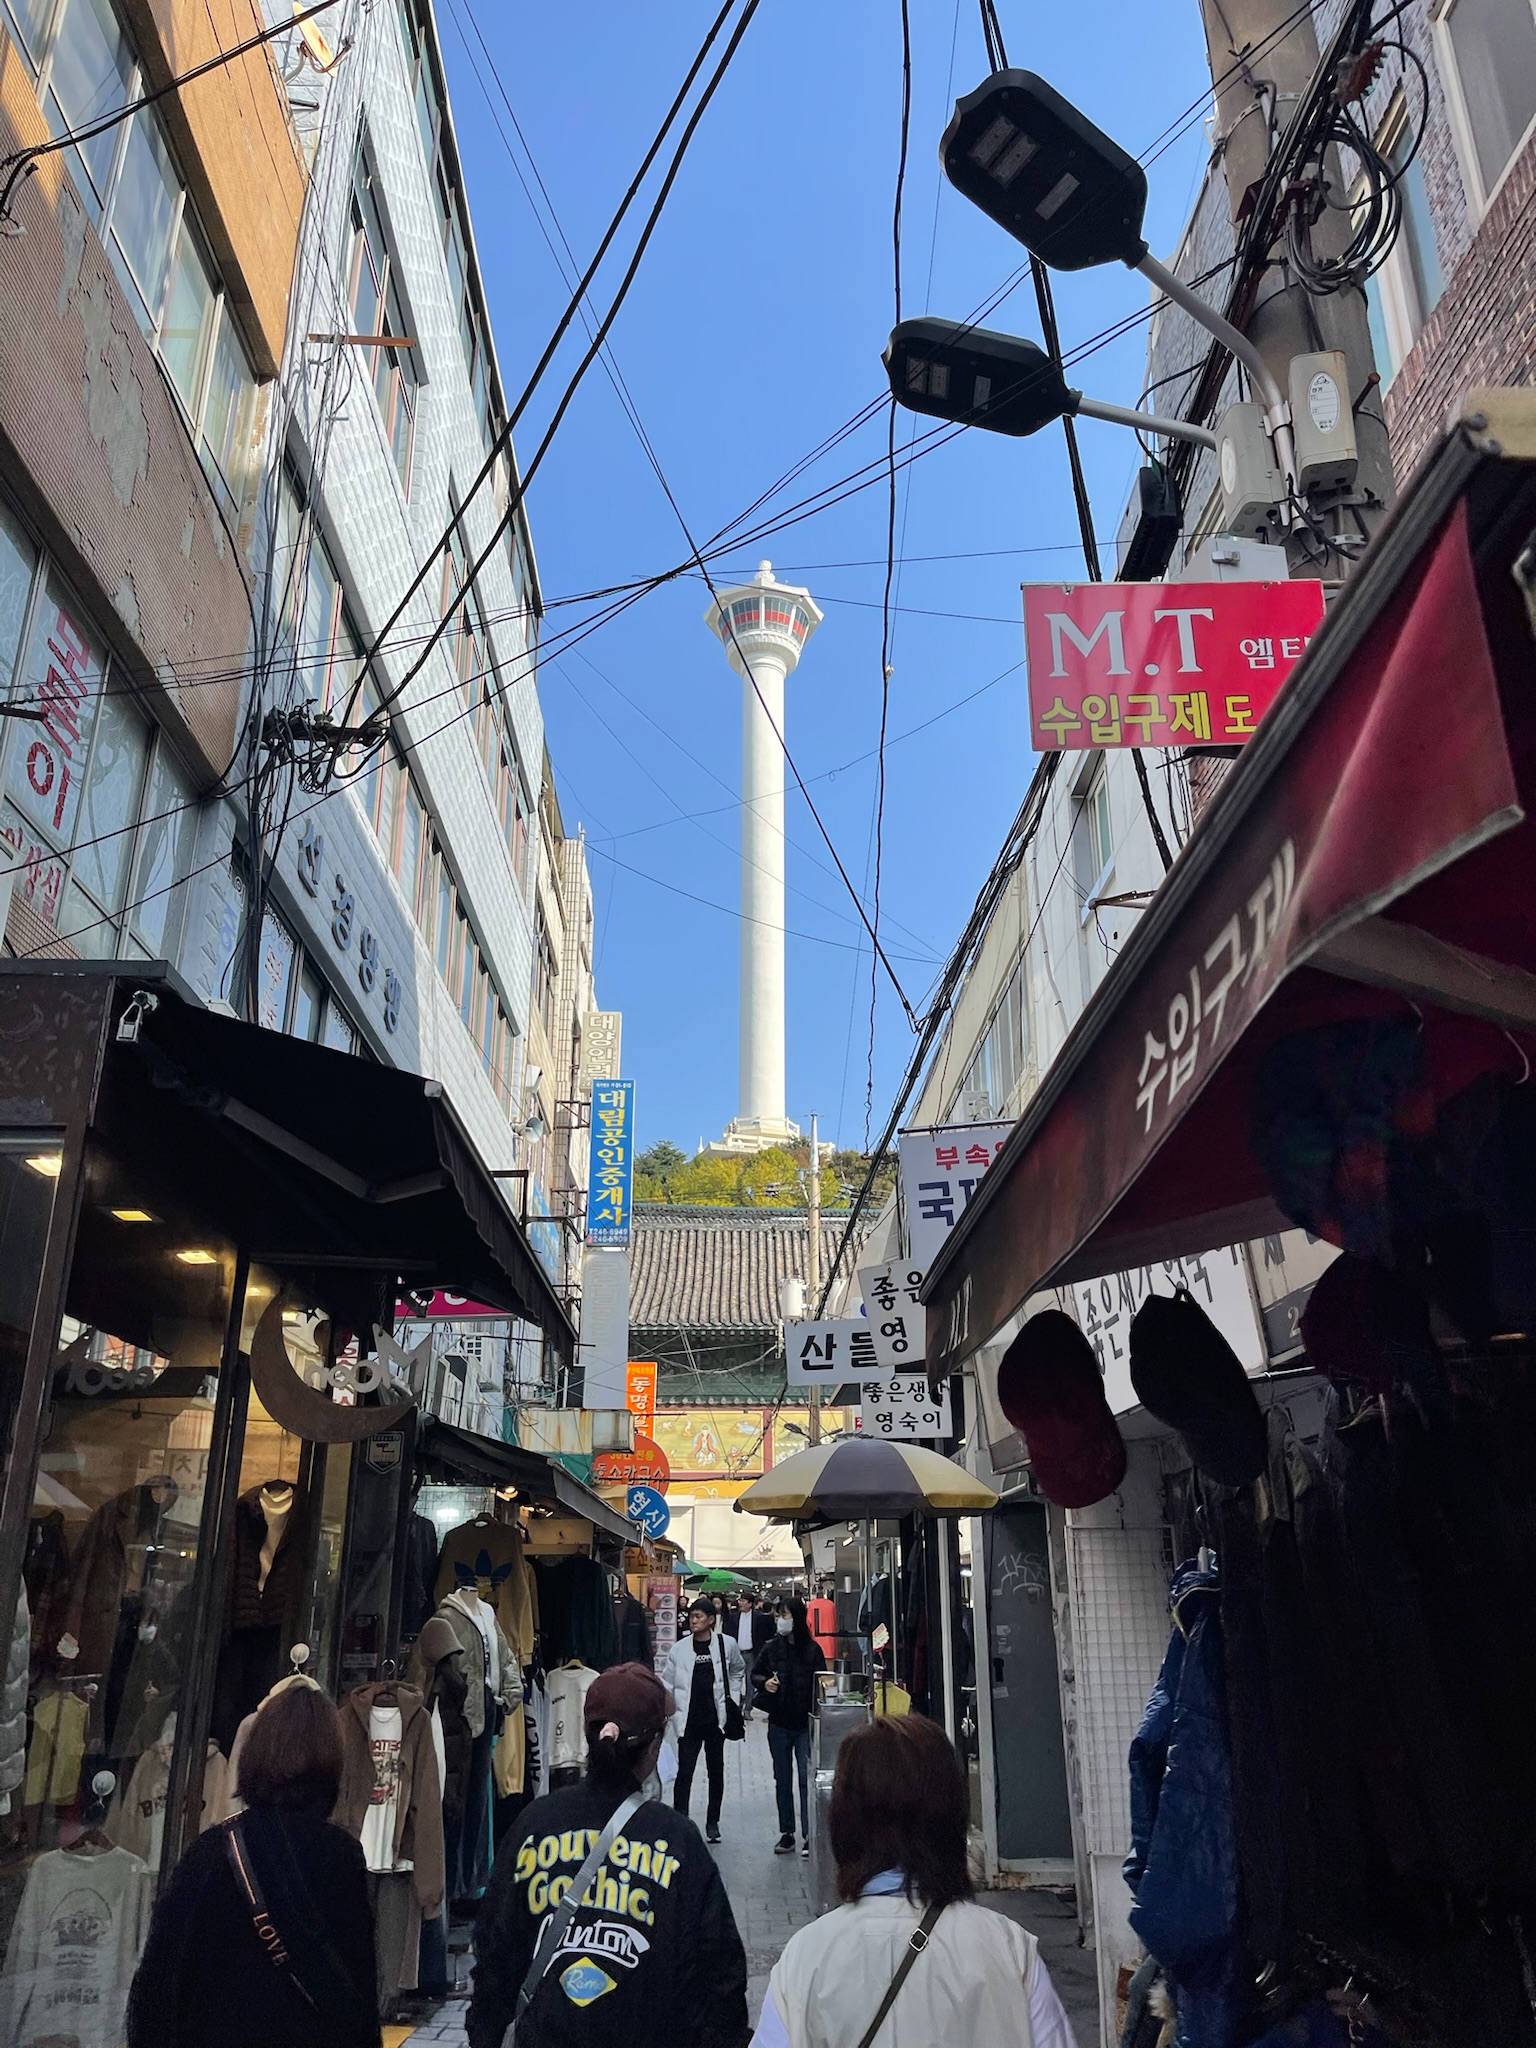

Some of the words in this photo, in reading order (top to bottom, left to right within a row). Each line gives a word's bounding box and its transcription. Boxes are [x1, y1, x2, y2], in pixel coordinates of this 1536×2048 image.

[1044, 607, 1214, 677] M.T
[1039, 691, 1212, 745] 수입구제
[1136, 838, 1297, 1133] 수입구제
[586, 1014, 616, 1079] 대양인력
[595, 1090, 629, 1226] 대림공인중개사
[864, 1381, 945, 1404] 좋은생
[875, 1411, 941, 1433] 영숙이
[253, 1911, 290, 1967] LOVE
